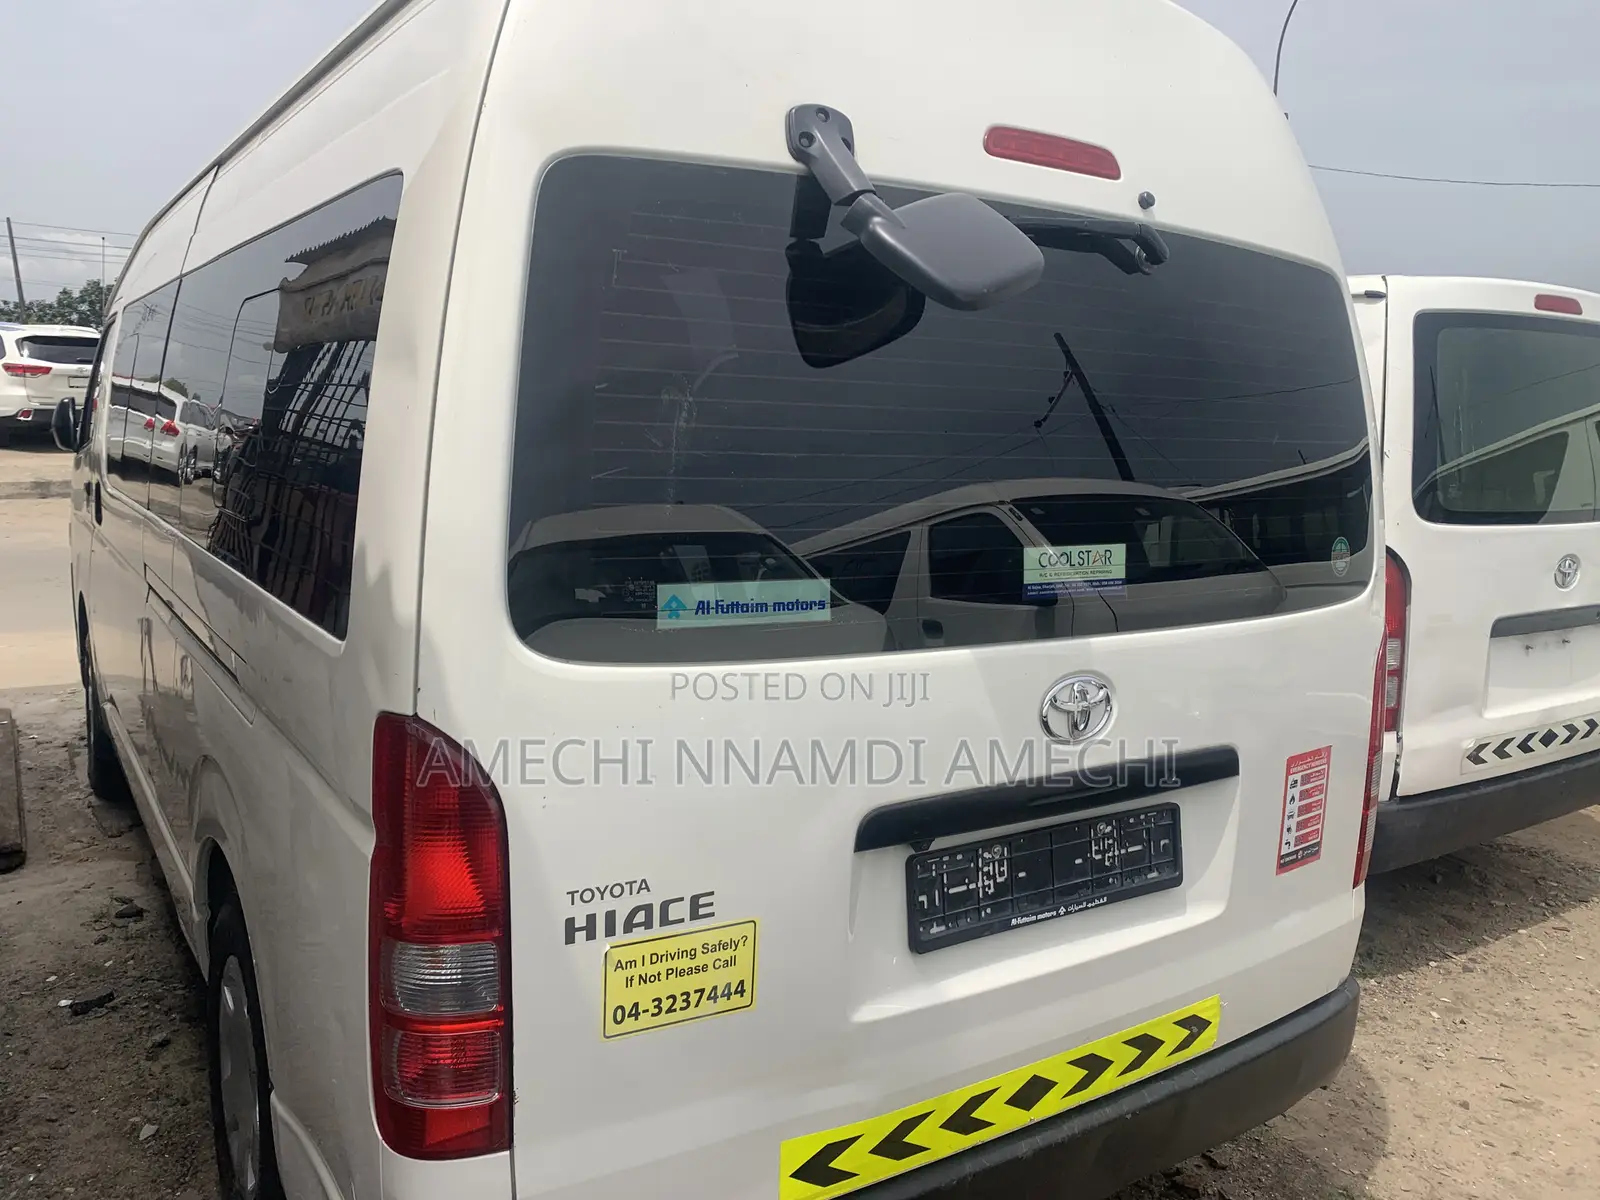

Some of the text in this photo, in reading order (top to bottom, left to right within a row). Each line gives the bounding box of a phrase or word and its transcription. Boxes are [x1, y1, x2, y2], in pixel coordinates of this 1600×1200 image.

[1038, 549, 1113, 569] COOLSTAR
[694, 598, 827, 616] Al-Futtaim motors
[566, 878, 651, 906] TOYOTA
[564, 891, 716, 946] HIACE
[1011, 910, 1057, 926] Al-Futtaim motors
[614, 935, 748, 972] Am I Driving Safely?
[625, 955, 737, 988] If Not Please Call
[612, 979, 746, 1025] 04-3237444
